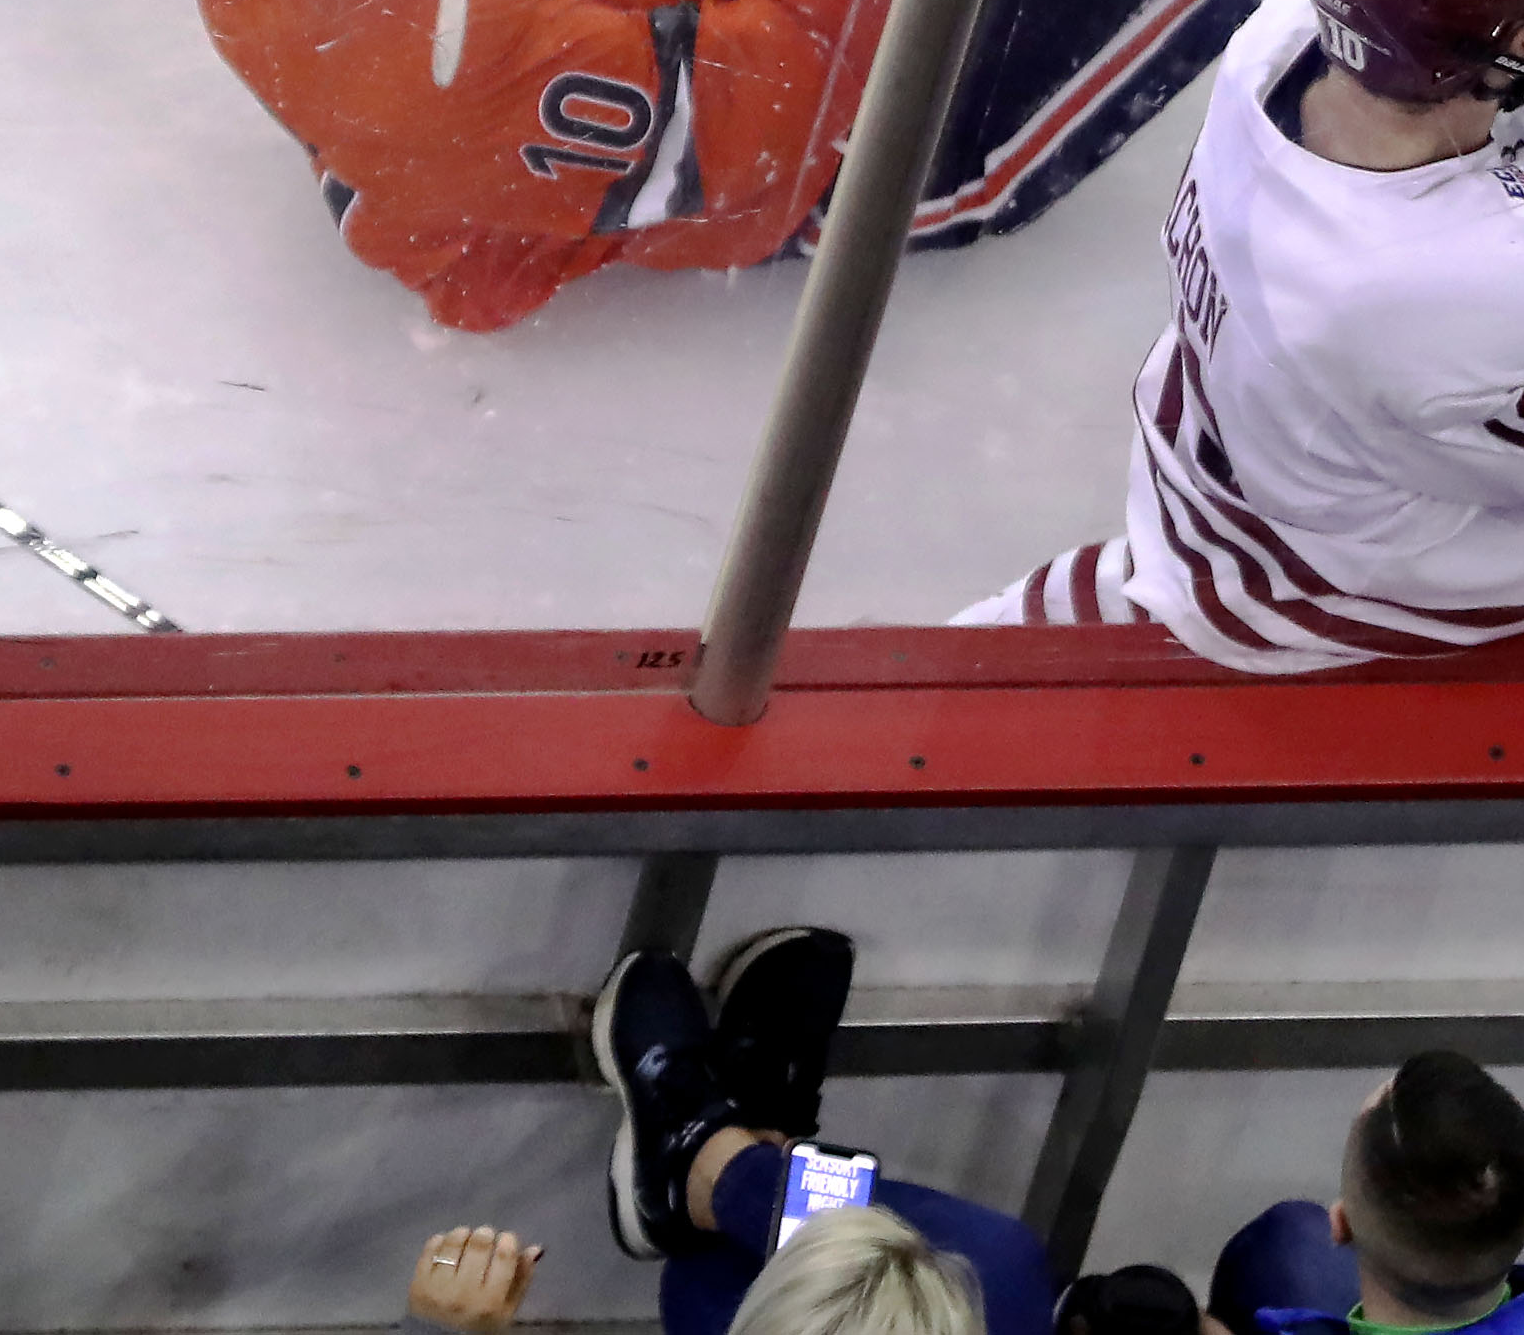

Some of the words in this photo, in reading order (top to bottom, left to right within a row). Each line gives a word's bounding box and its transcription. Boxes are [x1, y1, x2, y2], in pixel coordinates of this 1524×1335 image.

[1331, 17, 1366, 70] 10
[519, 71, 654, 181] 10
[800, 1170, 859, 1200] FRIENDLY
